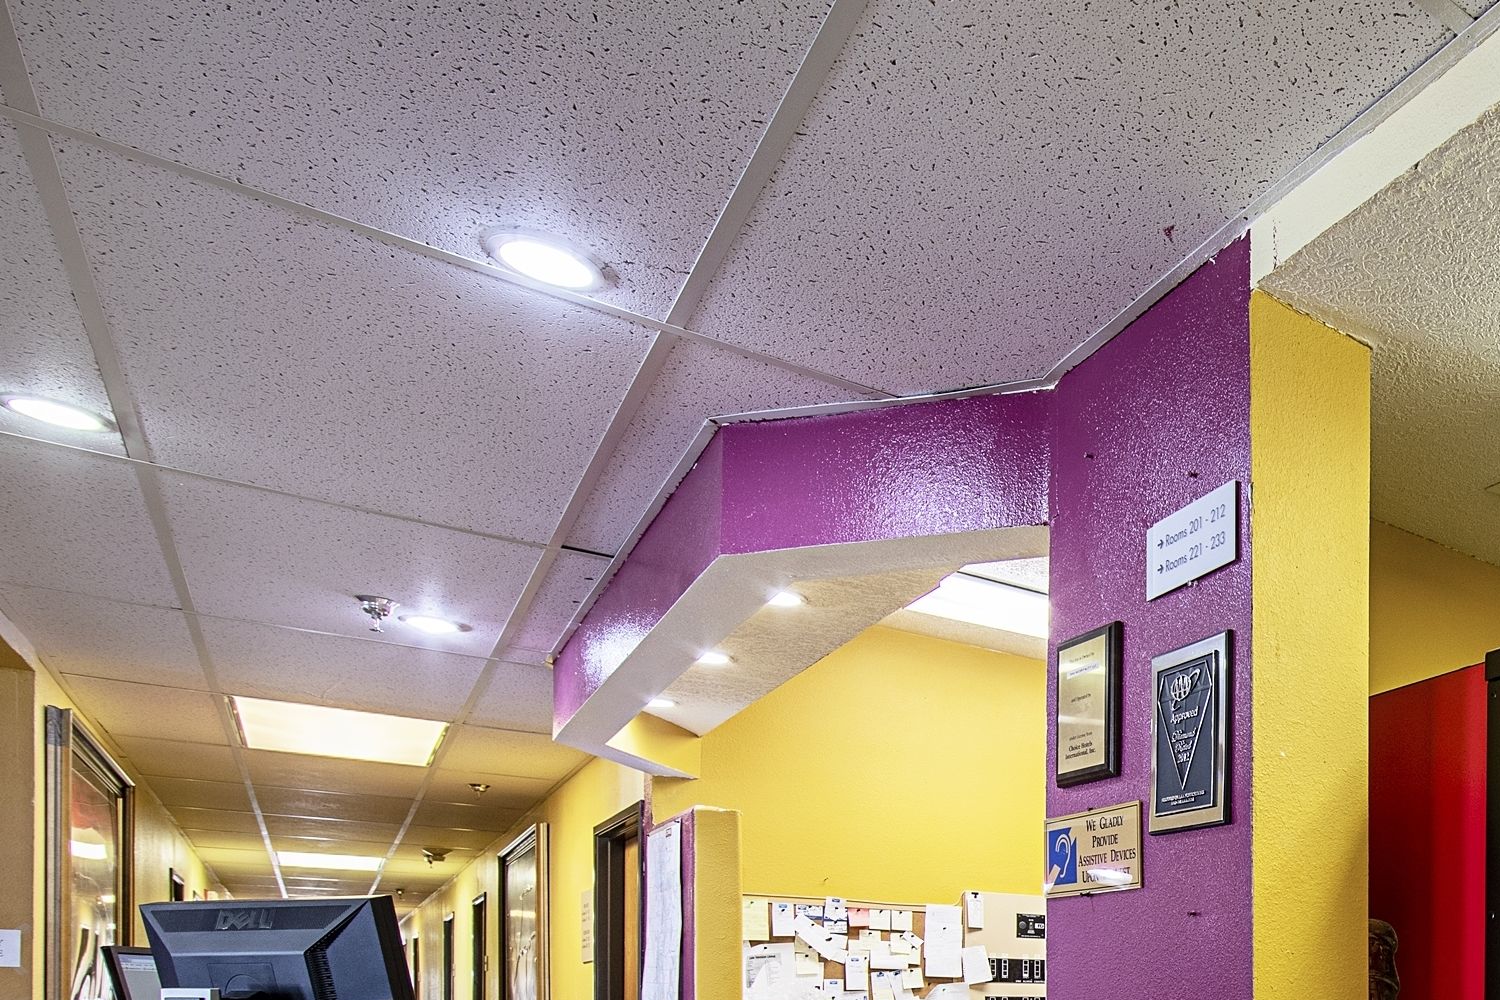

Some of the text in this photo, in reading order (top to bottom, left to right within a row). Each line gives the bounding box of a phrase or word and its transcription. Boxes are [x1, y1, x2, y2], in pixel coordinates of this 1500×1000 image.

[1165, 528, 1188, 547] Rooms
[1189, 516, 1202, 535] 201
[1210, 503, 1226, 523] 212
[1165, 554, 1188, 572] Rooms
[1189, 543, 1202, 561] 221
[1210, 531, 1226, 550] 233
[1170, 706, 1199, 724] Approved
[1068, 740, 1093, 753] Choice Hotels
[1086, 815, 1124, 832] WE GLADLY
[1092, 834, 1119, 848] PROVIDE
[1078, 848, 1136, 867] ASSISTIVE DEVICES
[215, 909, 273, 930] DELL
